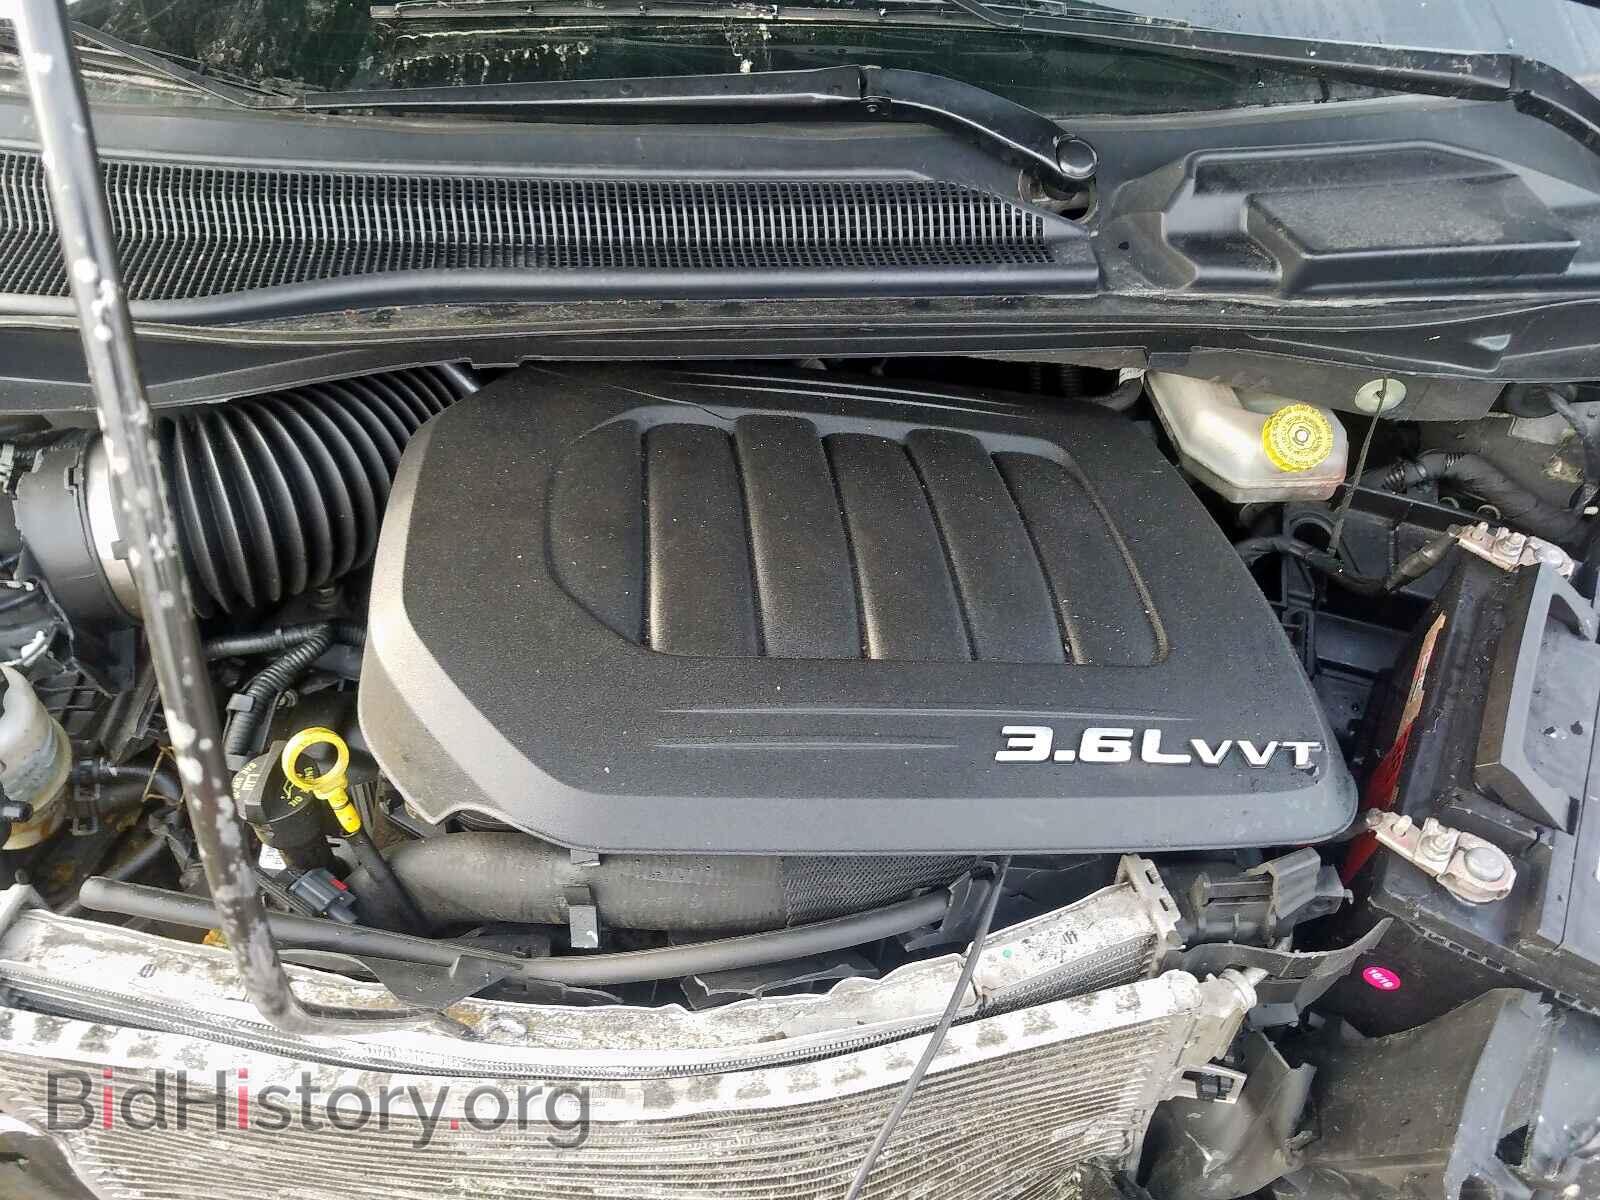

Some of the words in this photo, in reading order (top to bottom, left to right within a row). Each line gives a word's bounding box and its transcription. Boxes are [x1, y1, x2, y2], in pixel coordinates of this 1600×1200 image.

[994, 725, 1192, 765] 3.6L
[1190, 738, 1322, 769] VVT
[288, 795, 303, 807] OIL
